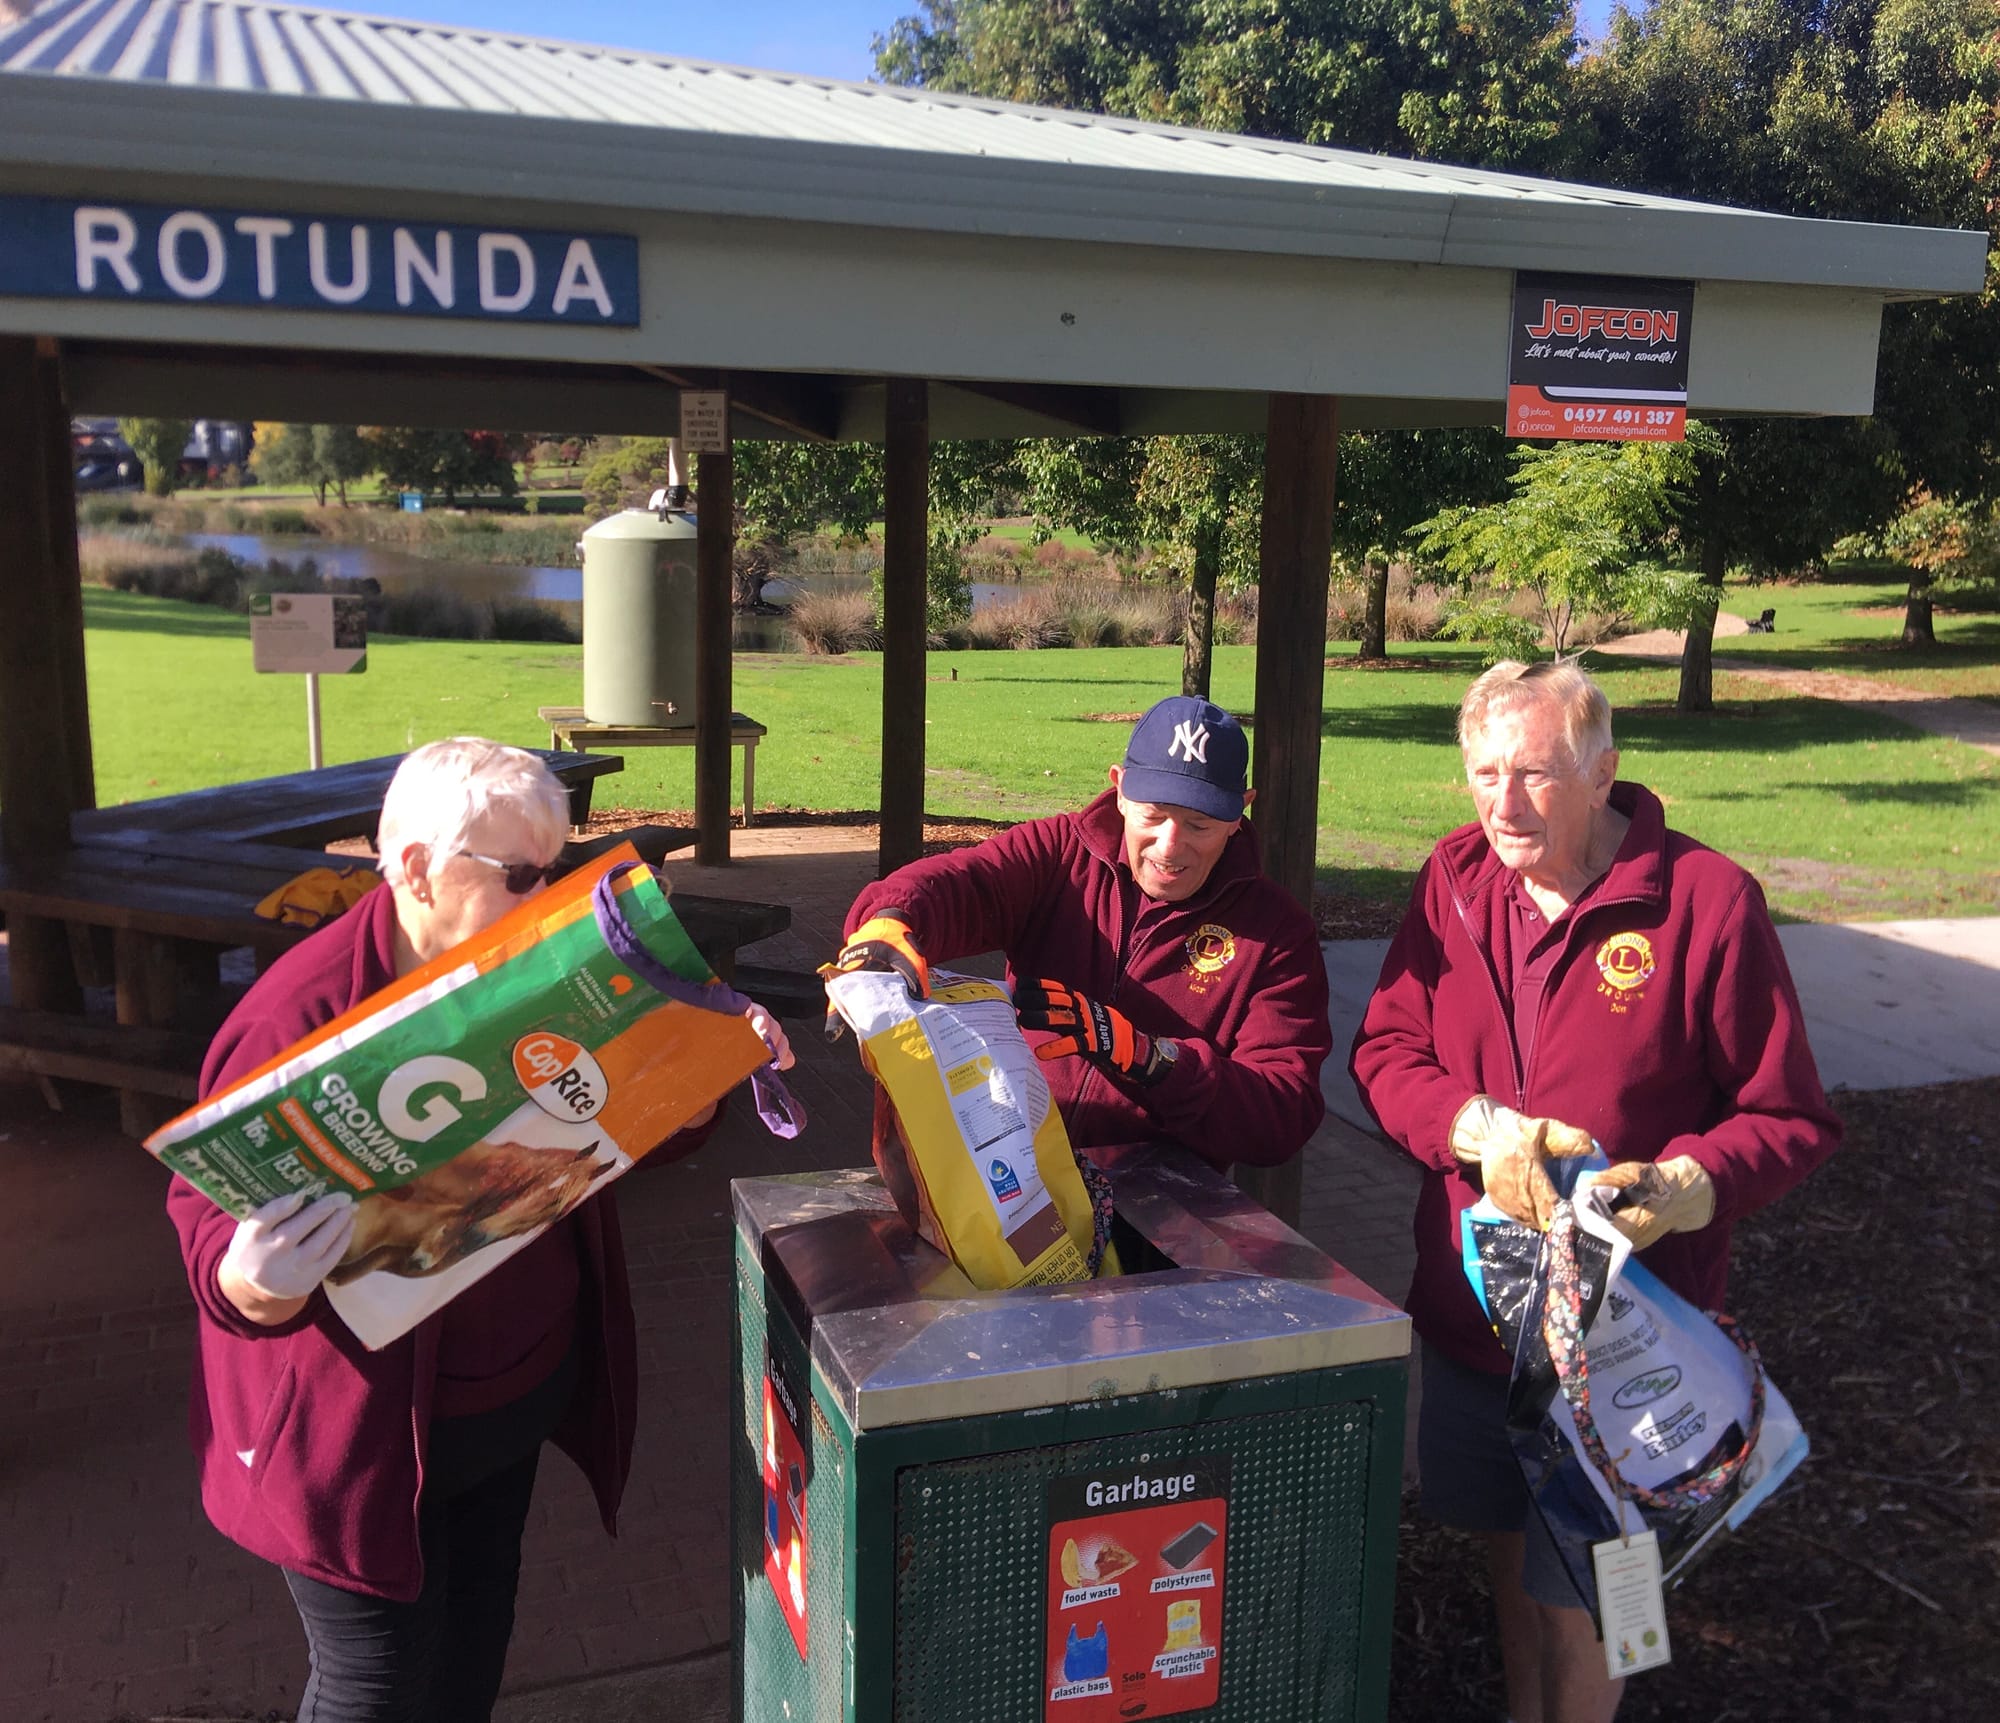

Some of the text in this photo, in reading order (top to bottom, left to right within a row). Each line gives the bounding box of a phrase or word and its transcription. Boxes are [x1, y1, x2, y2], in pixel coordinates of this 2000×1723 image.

[73, 206, 616, 318] ROTUNDA
[1524, 299, 1679, 347] JOFCON
[1525, 343, 1678, 364] Let's meet about your concrete!
[1564, 407, 1675, 425] 0497 491 387
[1529, 424, 1555, 432] JOFCON
[1572, 423, 1667, 437] jofconcrete@gmail.com
[1168, 720, 1210, 763] NY
[1203, 925, 1231, 939] LIONS
[1615, 934, 1647, 949] LIONS
[1200, 937, 1218, 957] L
[1616, 948, 1635, 970] L
[1100, 1023, 1110, 1050] Safety
[377, 1056, 487, 1144] G
[321, 1073, 417, 1175] GROWING
[312, 1100, 388, 1173] & BREEDING
[1065, 1246, 1076, 1258] OR
[1045, 1256, 1067, 1274] OTHER
[1047, 1271, 1068, 1285] FEED
[770, 1358, 798, 1427] Garbage
[1644, 1411, 1707, 1460] Barley
[1086, 1473, 1197, 1507] Garbage
[1154, 1571, 1212, 1592] polystyrene
[1064, 1587, 1118, 1604] food waste
[1155, 1648, 1216, 1668] scrunchable
[1122, 1672, 1146, 1683] Solo
[1168, 1661, 1202, 1677] plastic
[1054, 1686, 1085, 1699] plastic
[1087, 1680, 1110, 1693] bags
